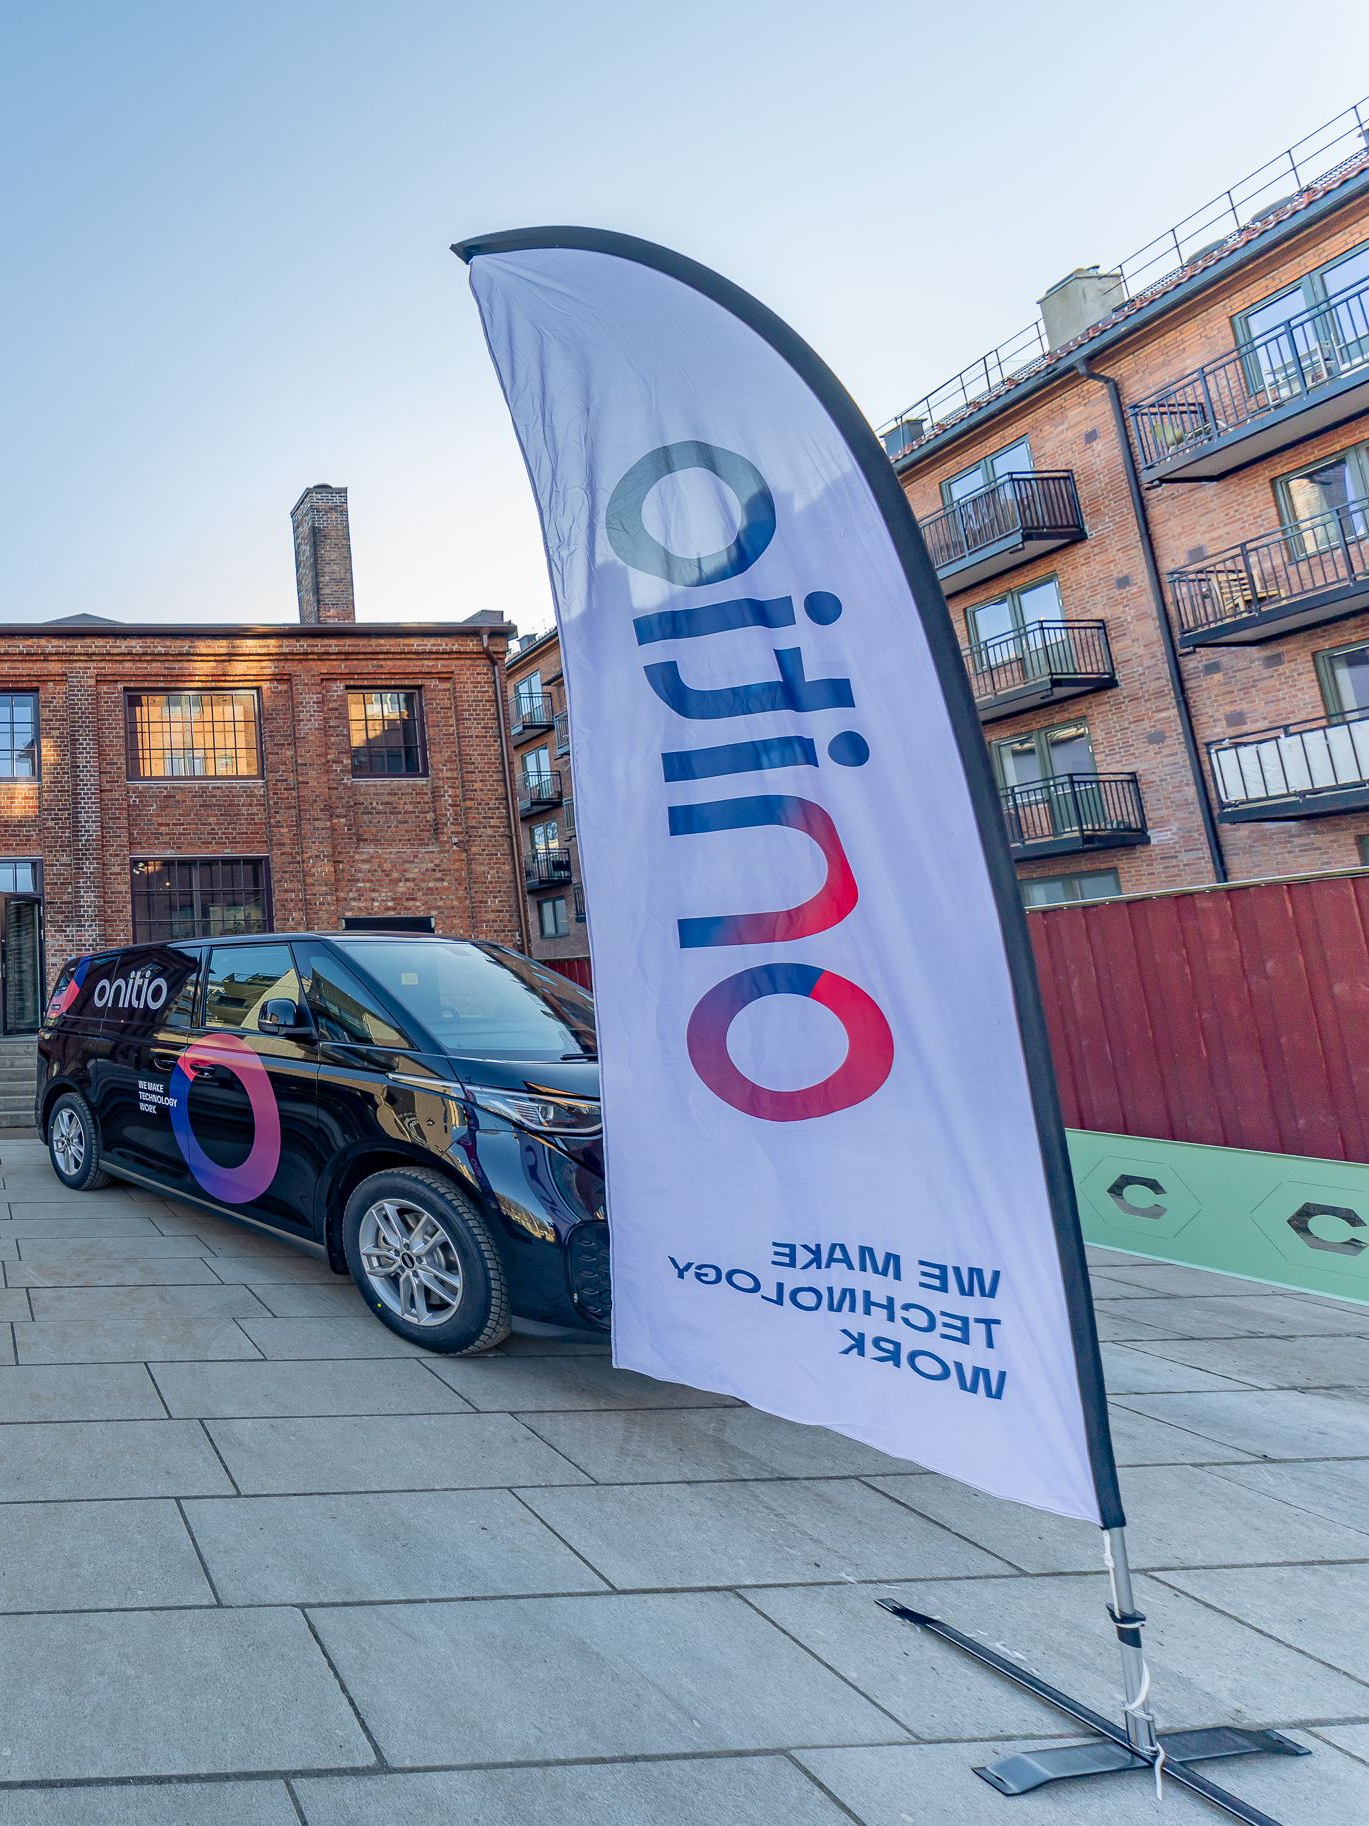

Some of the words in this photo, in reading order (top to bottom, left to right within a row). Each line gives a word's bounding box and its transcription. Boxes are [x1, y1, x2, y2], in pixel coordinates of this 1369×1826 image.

[93, 970, 168, 1010] onitio
[138, 1080, 148, 1090] WE
[147, 1082, 164, 1093] MAKE
[138, 1091, 178, 1108] TECHNOLOGY
[138, 1102, 157, 1114] WORK
